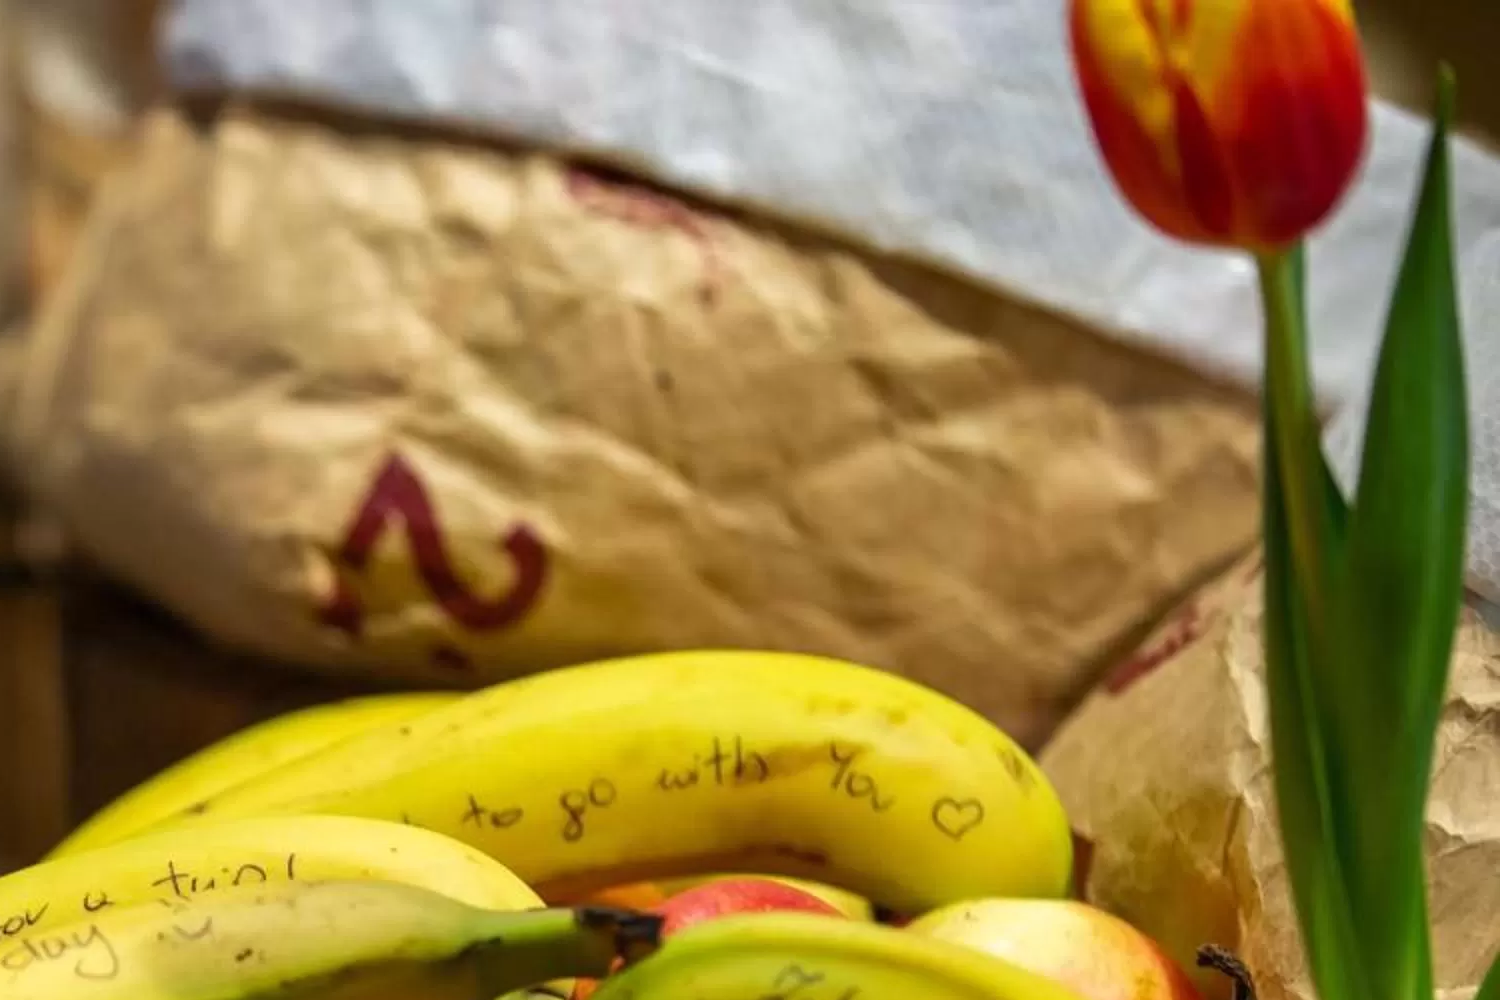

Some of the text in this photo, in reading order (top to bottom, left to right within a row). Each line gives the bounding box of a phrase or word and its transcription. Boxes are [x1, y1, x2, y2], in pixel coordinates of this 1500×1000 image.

[460, 792, 524, 830] to
[558, 777, 618, 843] go
[654, 734, 771, 792] with
[0, 922, 120, 981] day
